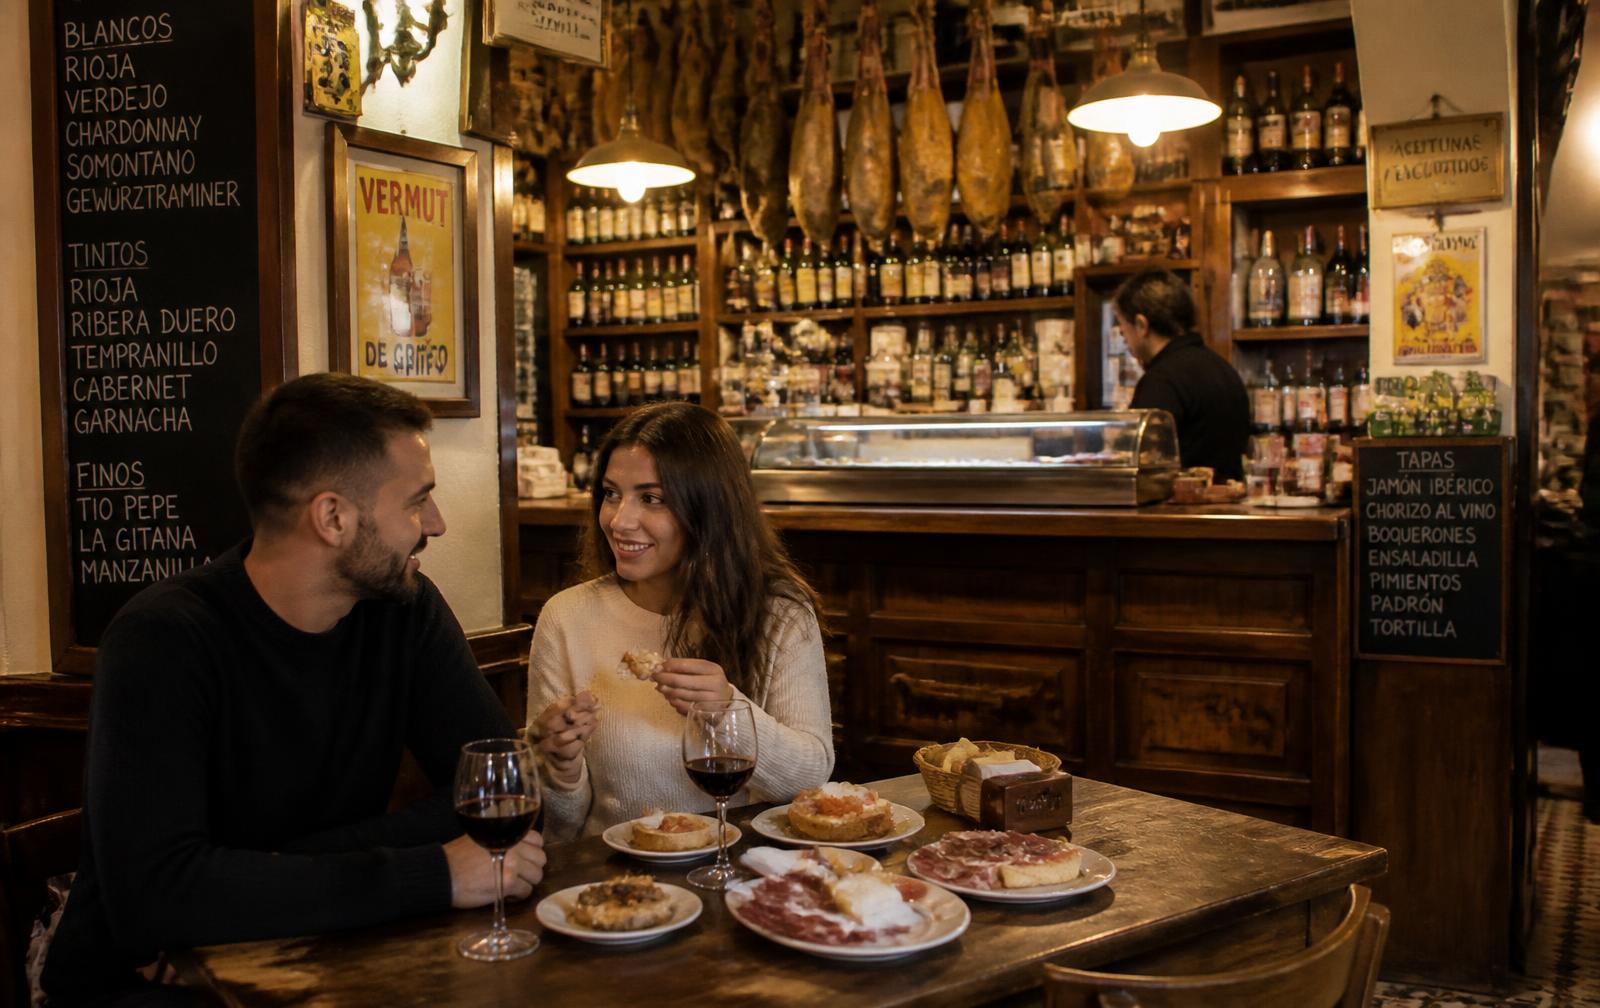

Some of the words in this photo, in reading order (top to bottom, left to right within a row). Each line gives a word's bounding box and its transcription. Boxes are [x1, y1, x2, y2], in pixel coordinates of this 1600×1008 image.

[64, 13, 173, 49] BLANCOS
[64, 53, 136, 82] RIOJA
[65, 84, 167, 114] VERDEJO
[65, 115, 202, 147] CHARDONNAY
[66, 150, 196, 180] SOMONTANO
[66, 181, 241, 214] GEWÜRZTRAMINER
[359, 176, 449, 228] VERMUT
[68, 240, 149, 268] TINTOS
[70, 276, 138, 304] RIOJA
[160, 306, 236, 334] DUERO
[71, 340, 218, 370] TEMPRANILLO
[365, 341, 387, 369] DE
[73, 374, 192, 401] CABERNET
[74, 407, 192, 434] GARNACHA
[1397, 451, 1455, 469] TAPAS
[76, 461, 145, 488] FINOS
[1366, 474, 1421, 495] JAMÓN
[1430, 473, 1494, 495] IBÉRICO
[76, 497, 113, 521] TIO
[124, 494, 180, 520] PEPE
[1366, 502, 1431, 519] CHORIZO
[1435, 503, 1455, 520] AL
[1460, 503, 1496, 520] VINO
[80, 527, 106, 552] LA
[116, 525, 197, 551] GITANA
[1368, 525, 1476, 546] BOQUERONES
[1368, 550, 1479, 568] ENSALADILLA
[1369, 572, 1462, 591] PIMIENTOS
[1370, 592, 1444, 614] PADRÓN
[1370, 618, 1457, 638] TORTILLA
